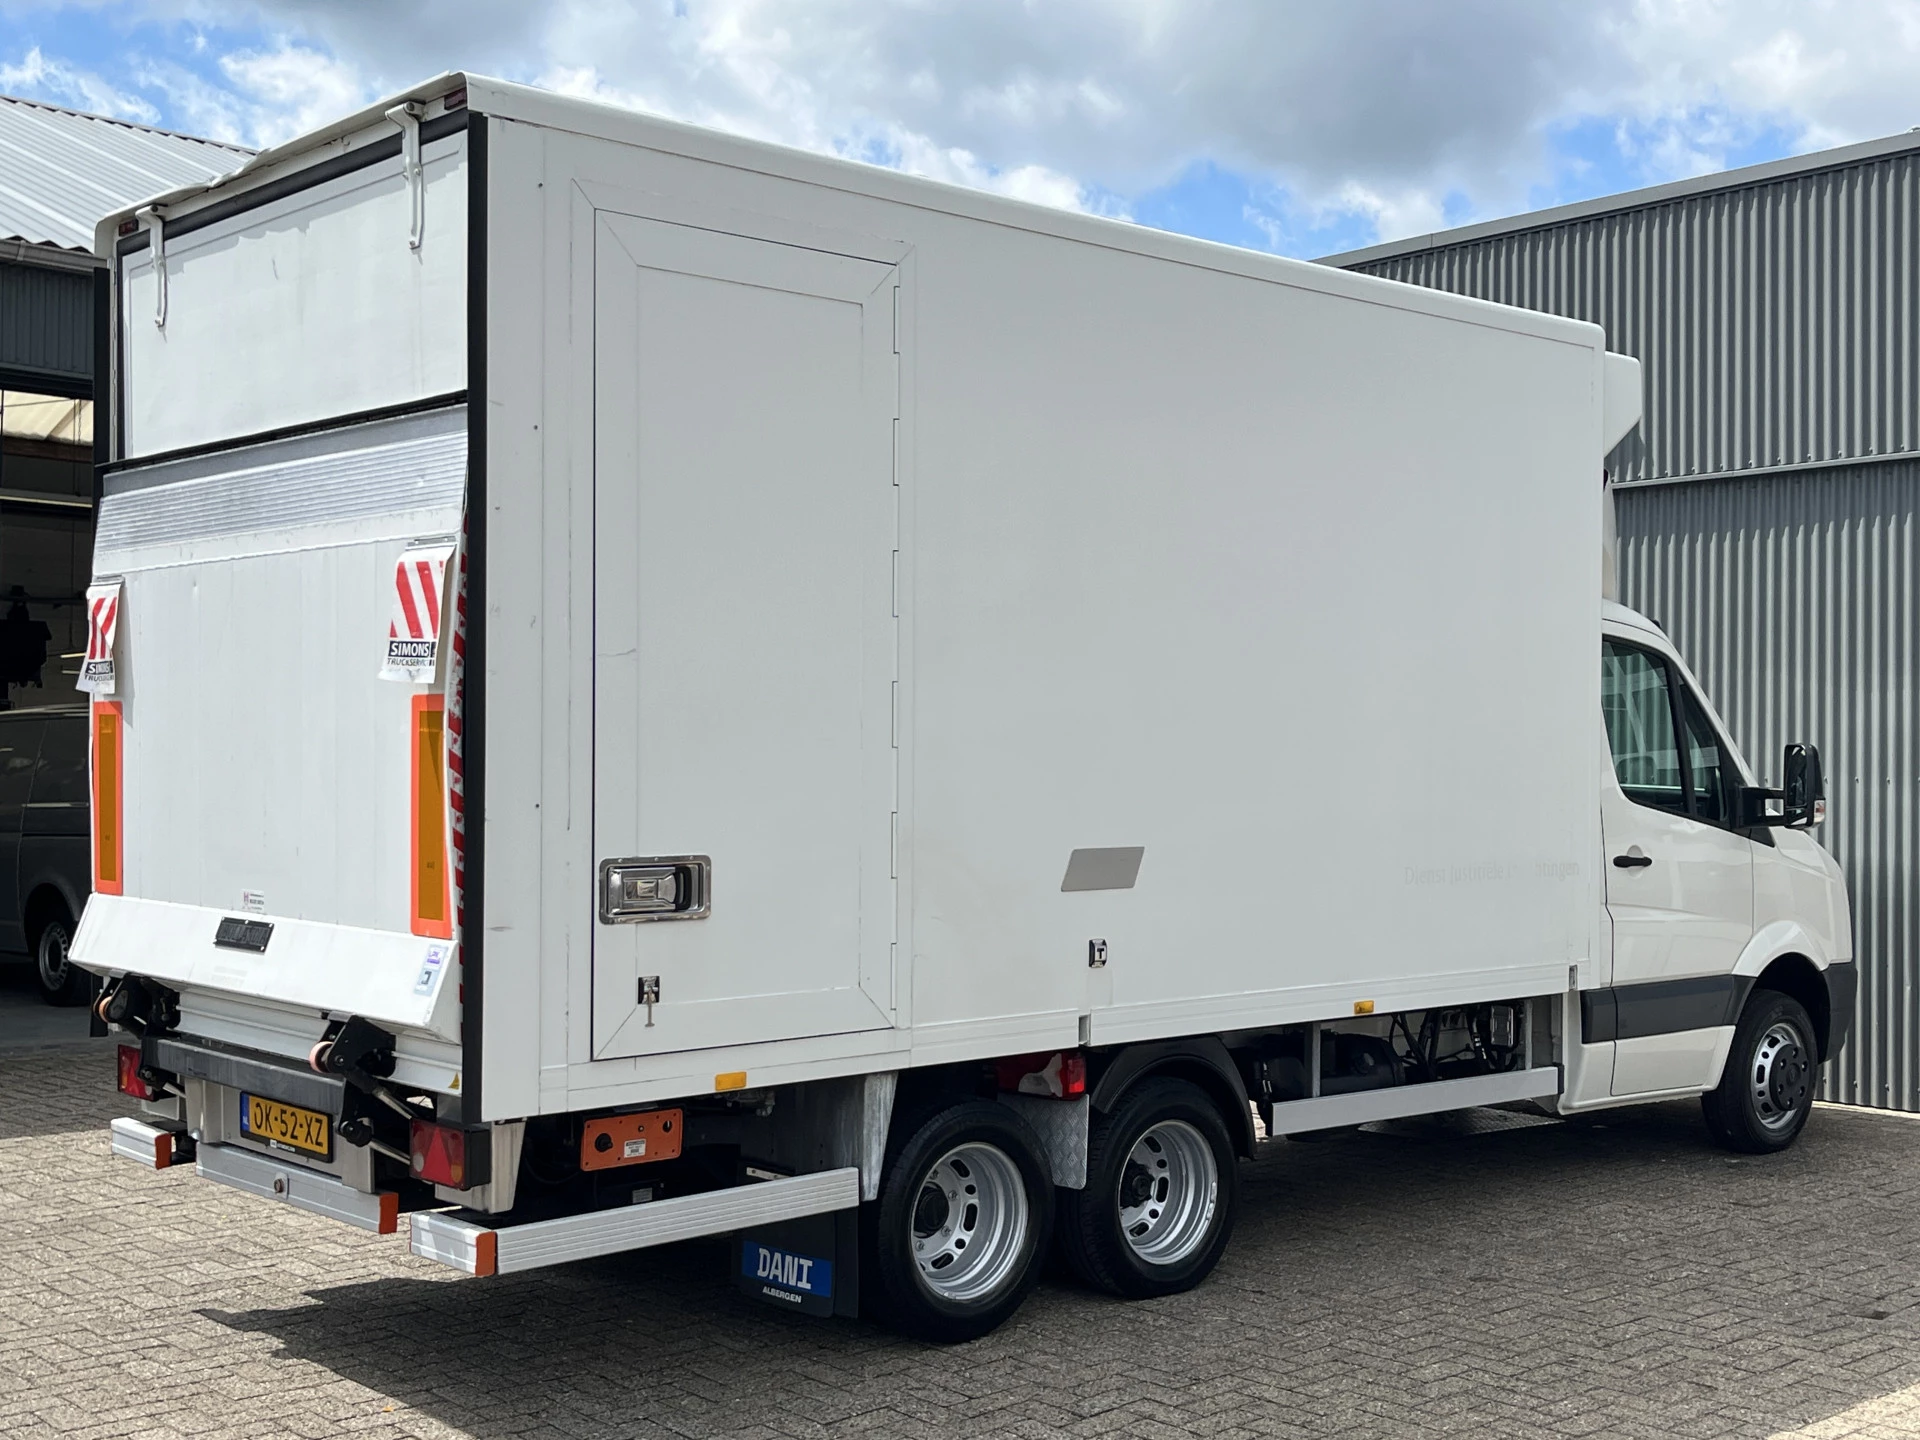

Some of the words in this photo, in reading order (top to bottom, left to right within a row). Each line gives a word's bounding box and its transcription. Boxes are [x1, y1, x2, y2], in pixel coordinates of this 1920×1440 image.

[391, 643, 429, 656] SIMONS
[254, 1102, 323, 1147] OK-52-XZ
[757, 1248, 812, 1289] DANI
[762, 1286, 801, 1303] ALBERGEN
